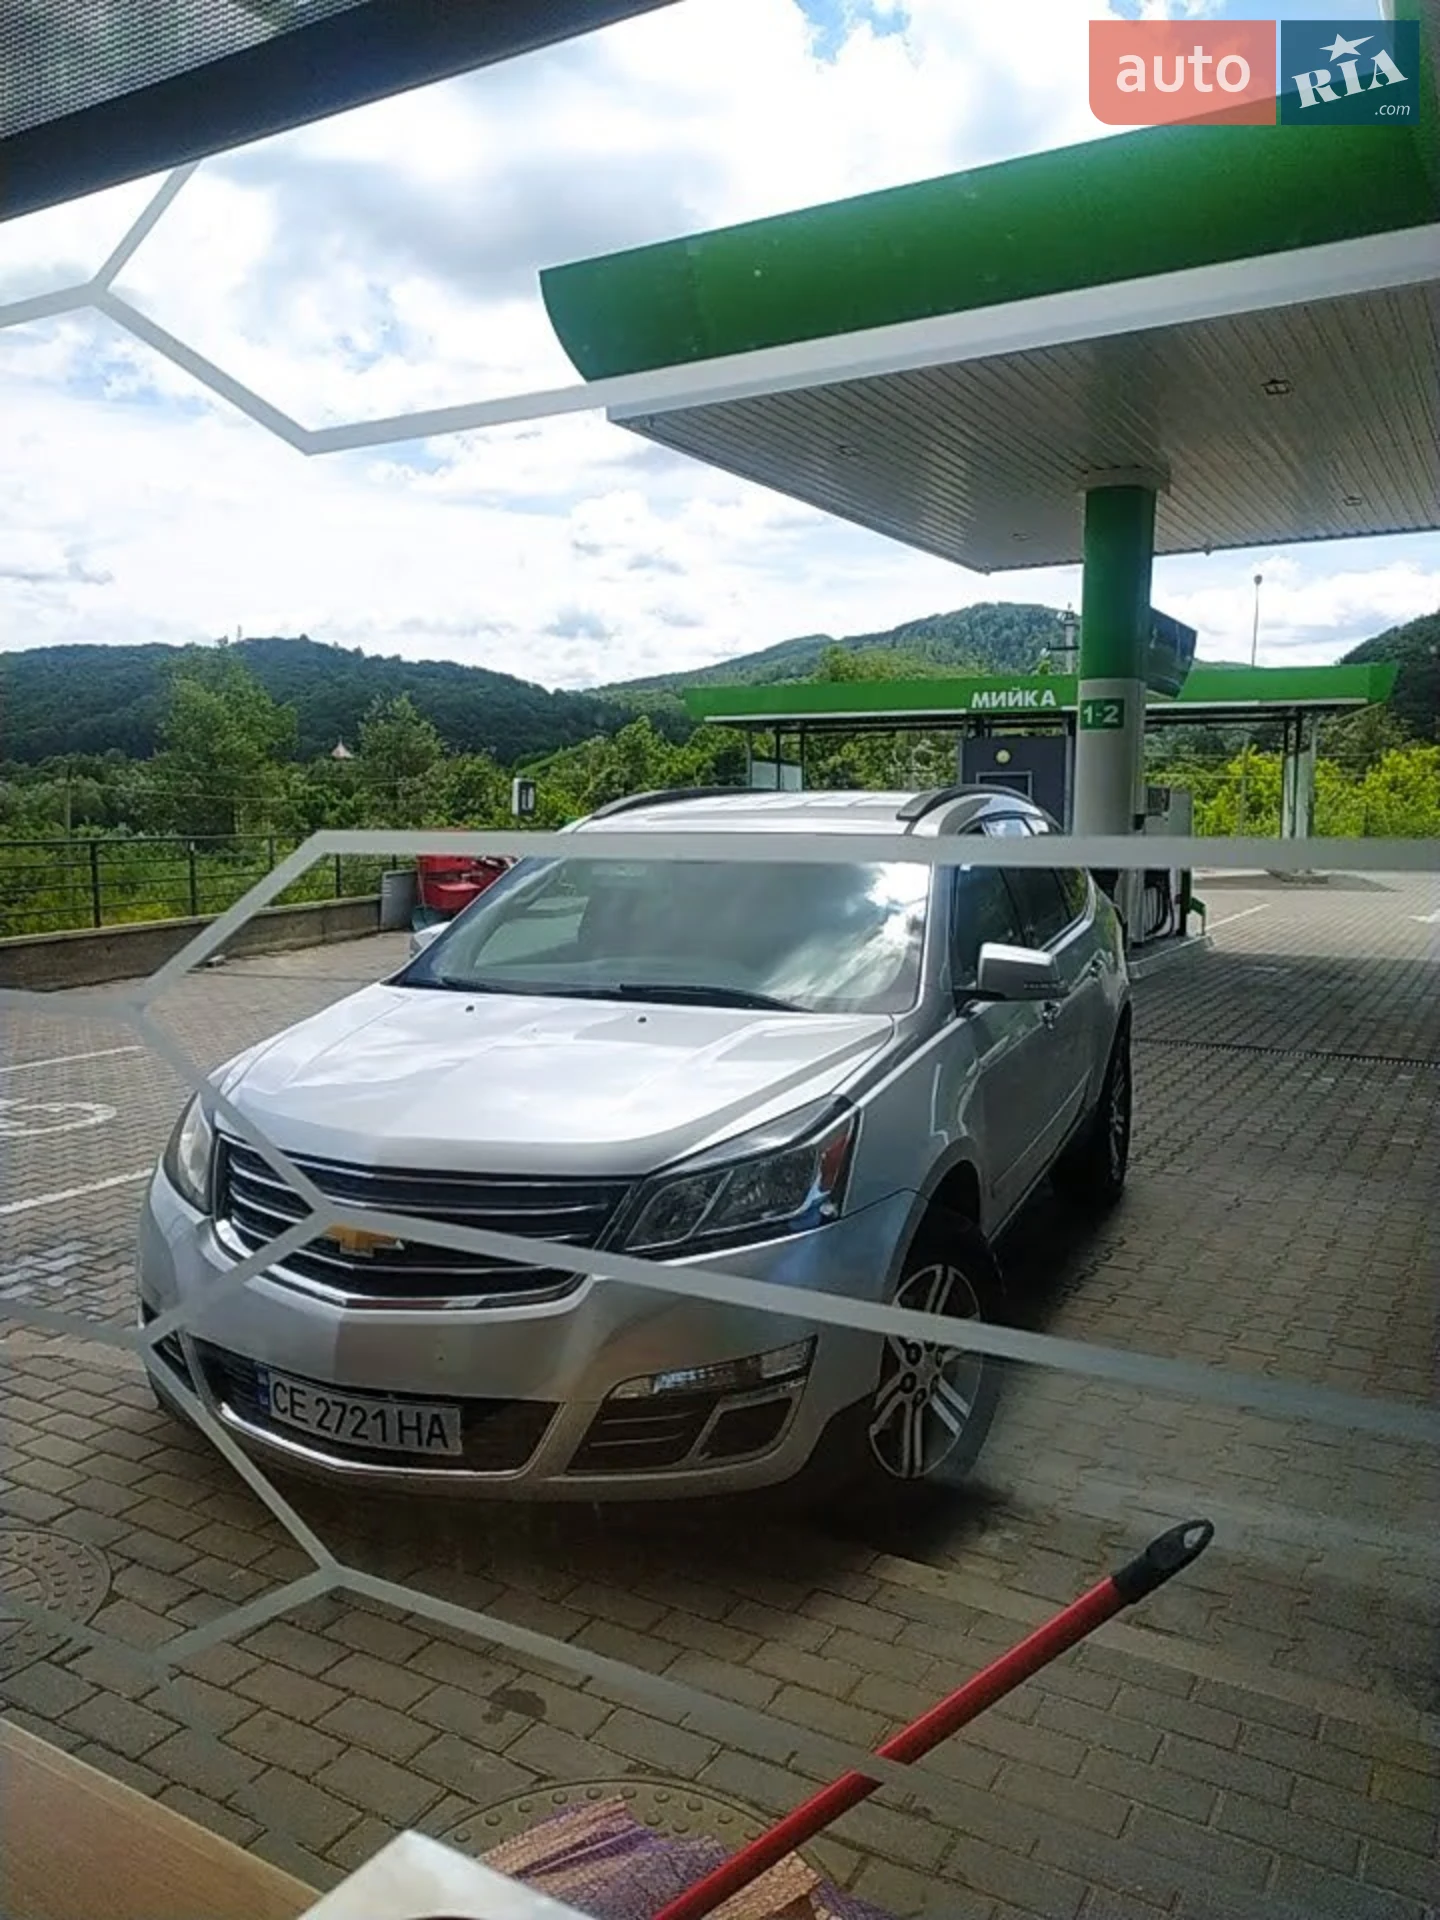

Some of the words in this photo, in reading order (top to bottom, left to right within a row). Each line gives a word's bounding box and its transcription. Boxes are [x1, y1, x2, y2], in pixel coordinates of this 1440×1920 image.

[971, 687, 1056, 709] МИЙКА
[1082, 704, 1119, 725] 1-2
[272, 1381, 308, 1424] CE
[315, 1397, 387, 1443] 2721
[397, 1410, 448, 1449] HA
